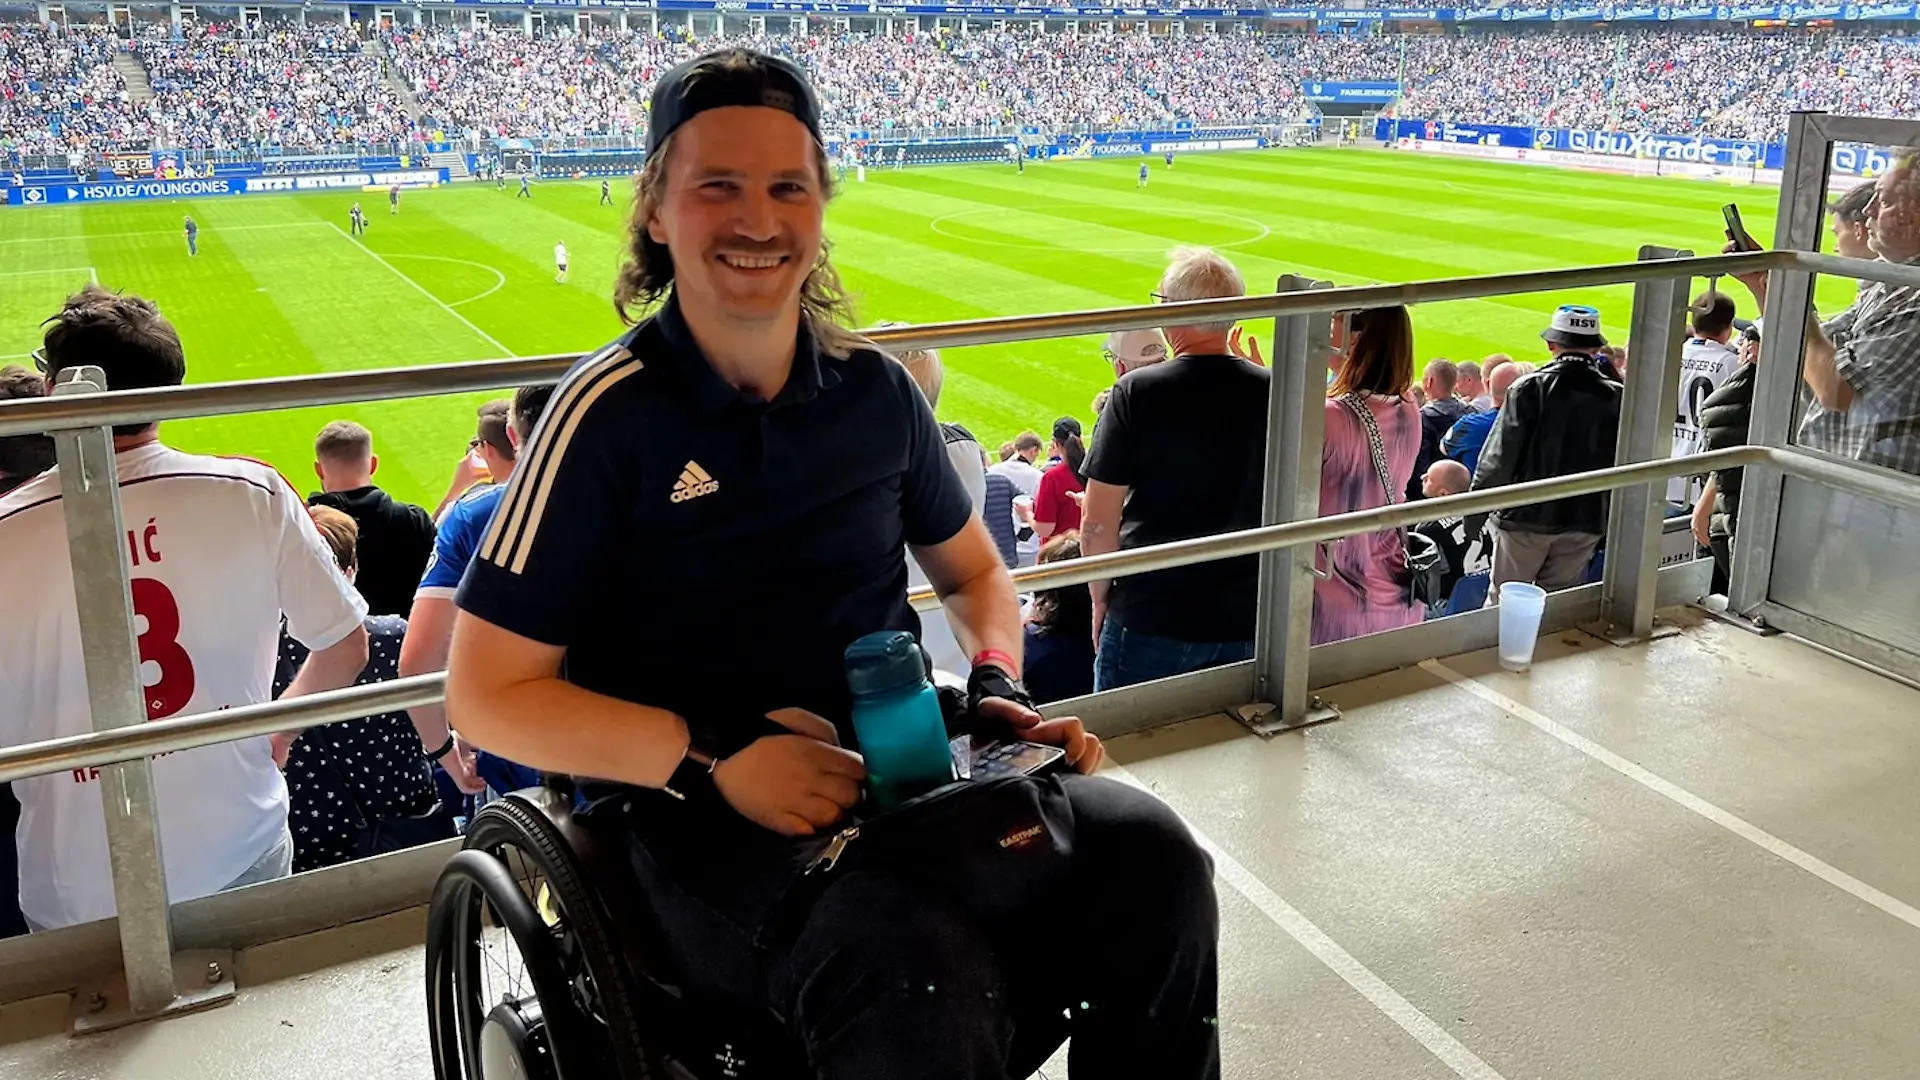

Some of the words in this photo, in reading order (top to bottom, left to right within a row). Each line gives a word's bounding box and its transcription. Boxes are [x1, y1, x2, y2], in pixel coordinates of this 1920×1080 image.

[1594, 129, 1718, 162] buXtrade
[84, 181, 229, 199] HSV.DE/YOUNGONES
[1569, 318, 1596, 328] HSV
[670, 480, 719, 503] adidas
[1000, 825, 1042, 848] EASTPAK
